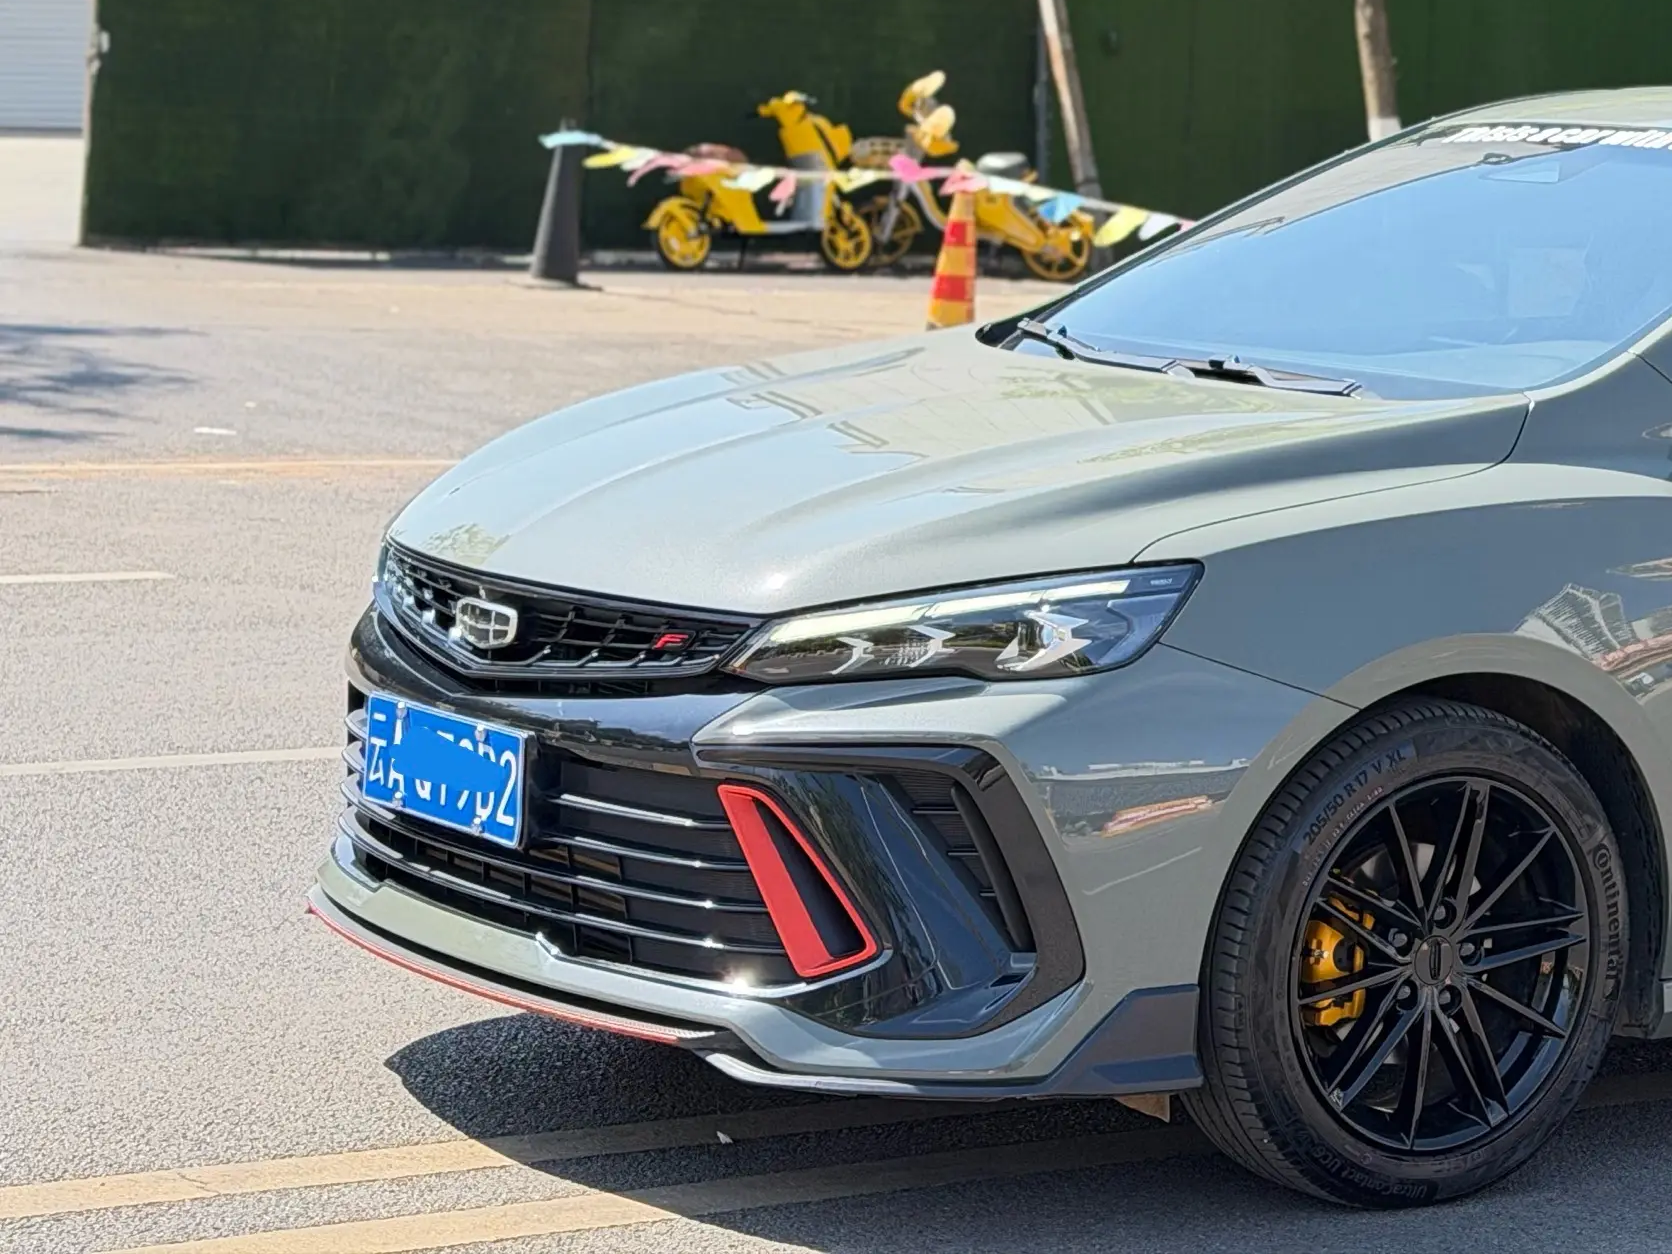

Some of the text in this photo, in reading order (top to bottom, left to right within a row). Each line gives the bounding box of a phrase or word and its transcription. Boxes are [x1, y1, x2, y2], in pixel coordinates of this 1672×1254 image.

[1303, 793, 1345, 845] 205/50
[1371, 759, 1382, 775] V
[1385, 749, 1406, 767] XL
[1593, 843, 1621, 981] Continental
[1342, 1165, 1427, 1199] UltraContact
